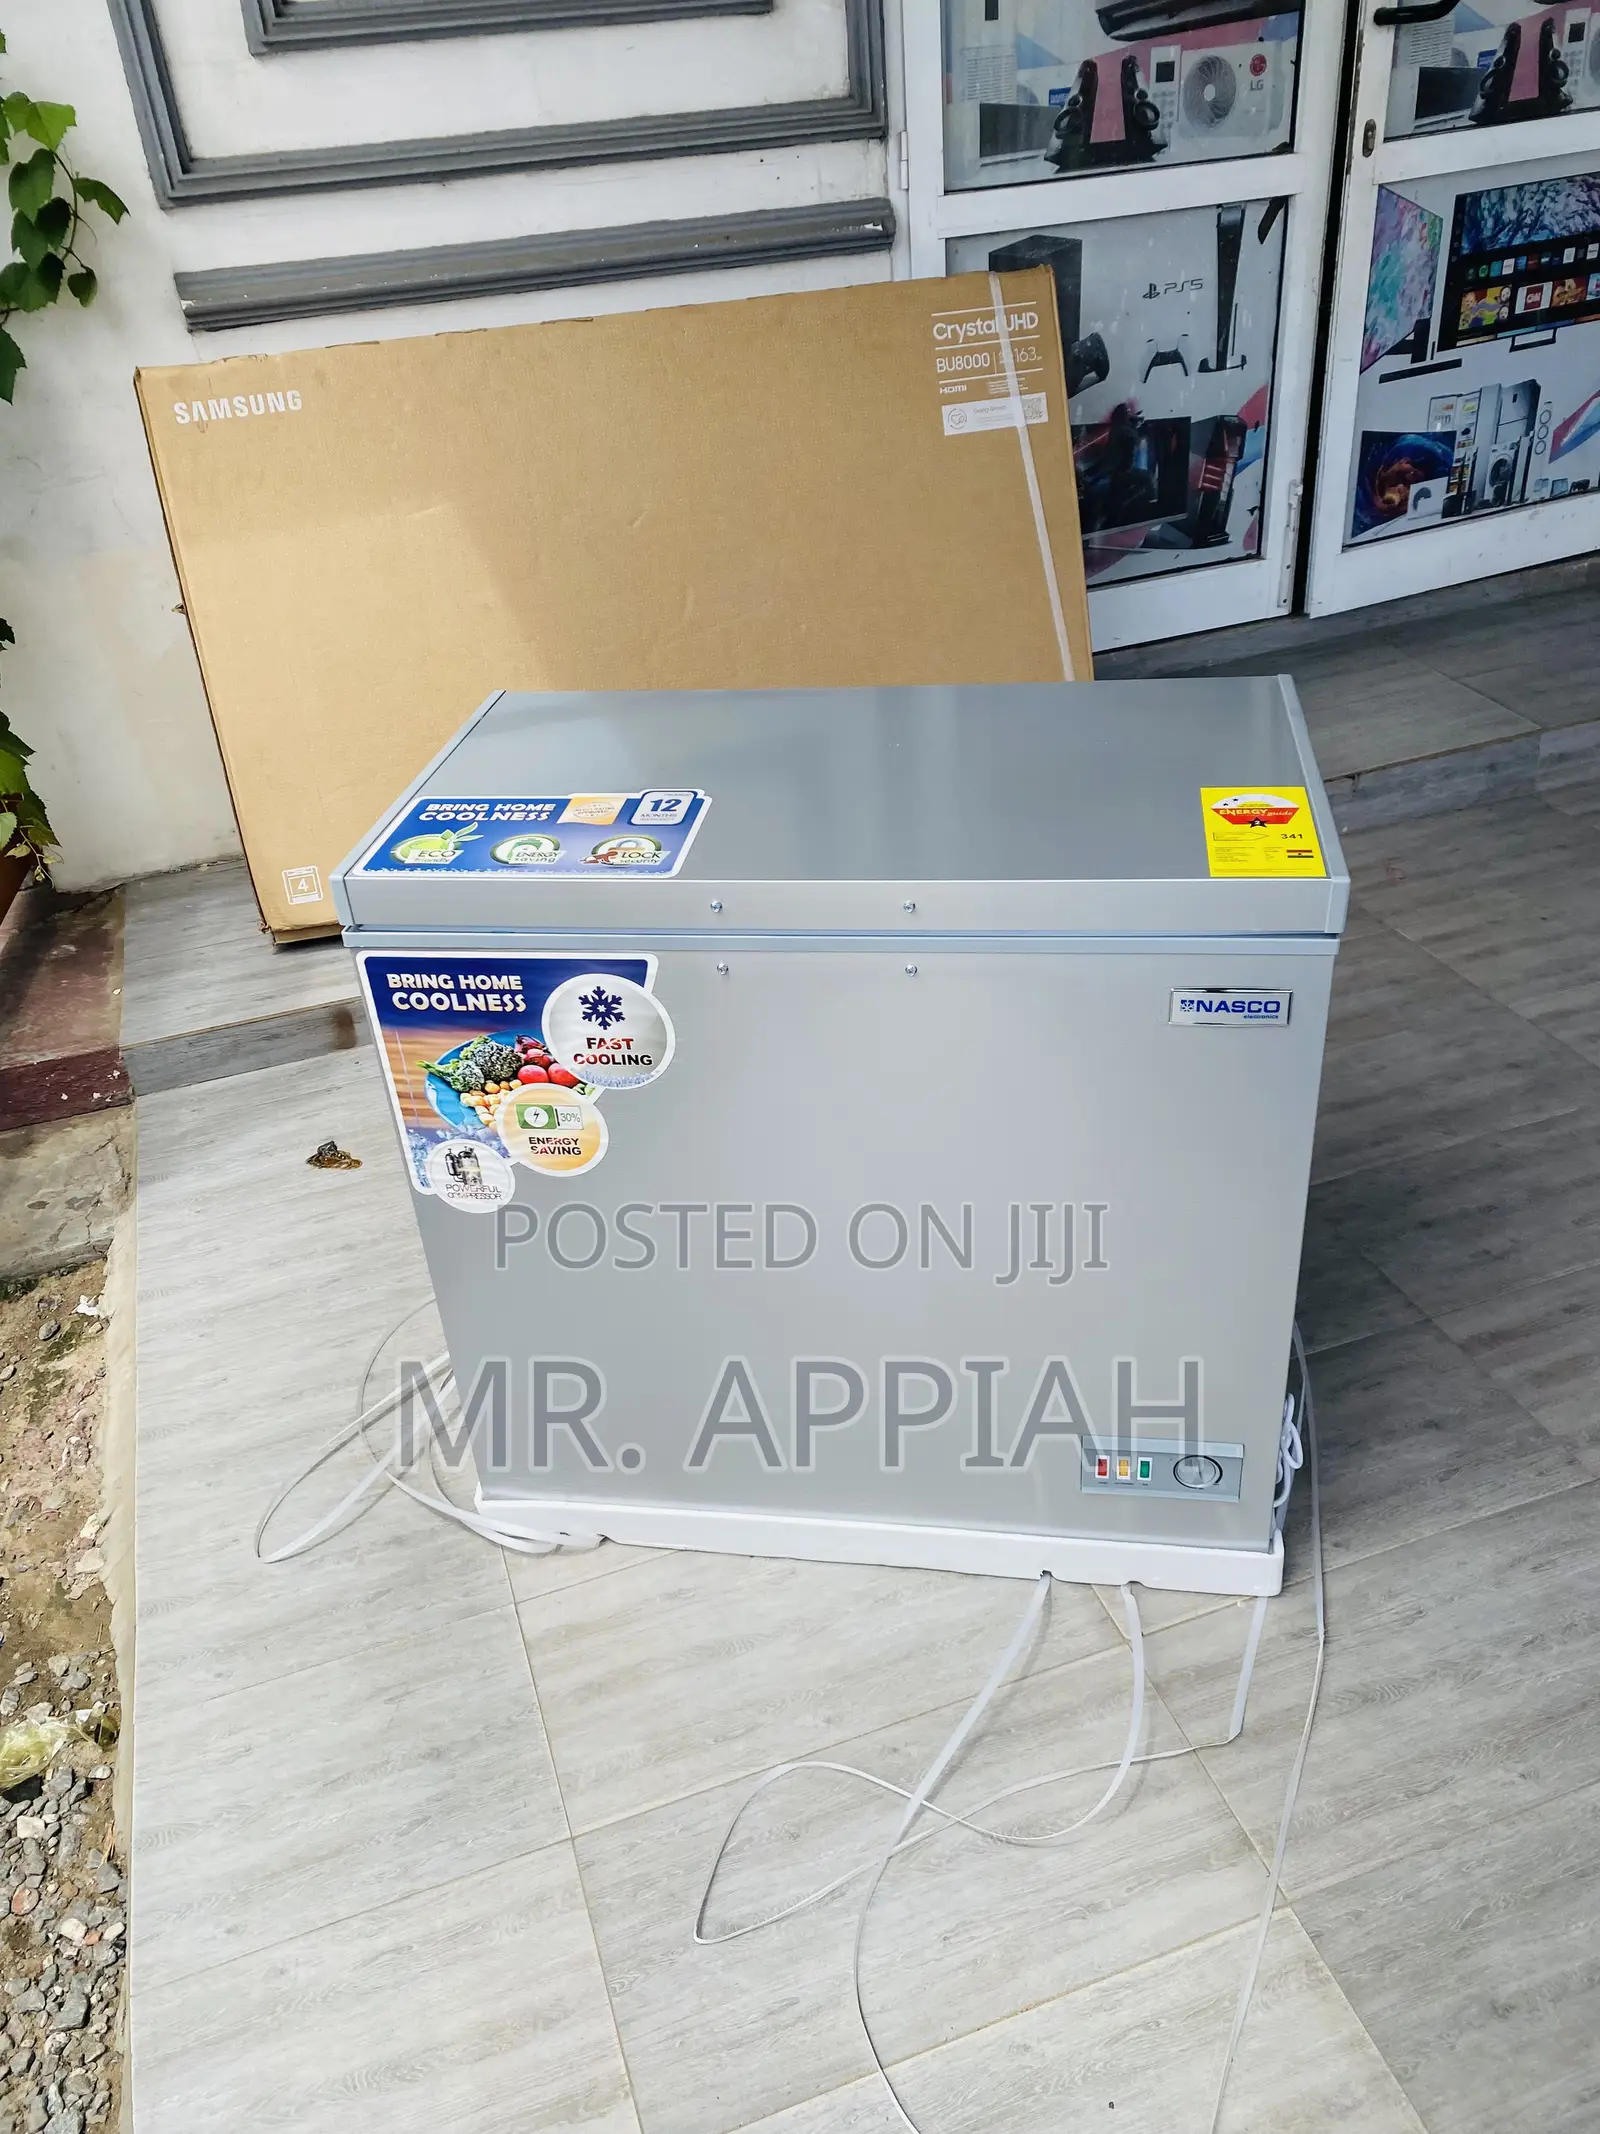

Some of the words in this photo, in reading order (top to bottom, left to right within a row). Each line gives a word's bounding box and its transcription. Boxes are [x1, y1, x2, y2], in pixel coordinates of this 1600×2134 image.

[1249, 79, 1264, 91] LG
[1164, 278, 1204, 294] PS5
[932, 315, 999, 343] Crystal
[1004, 312, 1039, 331] UHD
[936, 352, 991, 373] BU8000
[940, 384, 967, 394] HDMI
[174, 389, 302, 424] SAMSUNG
[425, 803, 490, 811] BRING
[494, 803, 556, 811] HOME
[650, 799, 682, 812] 12
[418, 811, 551, 821] COOLNESS
[1219, 808, 1268, 816] ENERGY
[418, 850, 456, 858] ECO
[621, 851, 662, 859] LOCK
[386, 973, 455, 990] BRING
[459, 974, 523, 991] HOME
[392, 992, 527, 1013] COOLNESS
[1196, 1000, 1280, 1013] NASCO
[586, 1037, 634, 1050] FAST
[573, 1053, 653, 1066] COOLING
[559, 1112, 581, 1123] 30%
[528, 1136, 579, 1146] ENERGY
[530, 1145, 582, 1156] SAVING
[445, 1184, 502, 1193] POWERFUL
[447, 1192, 502, 1200] COMPRESSOR
